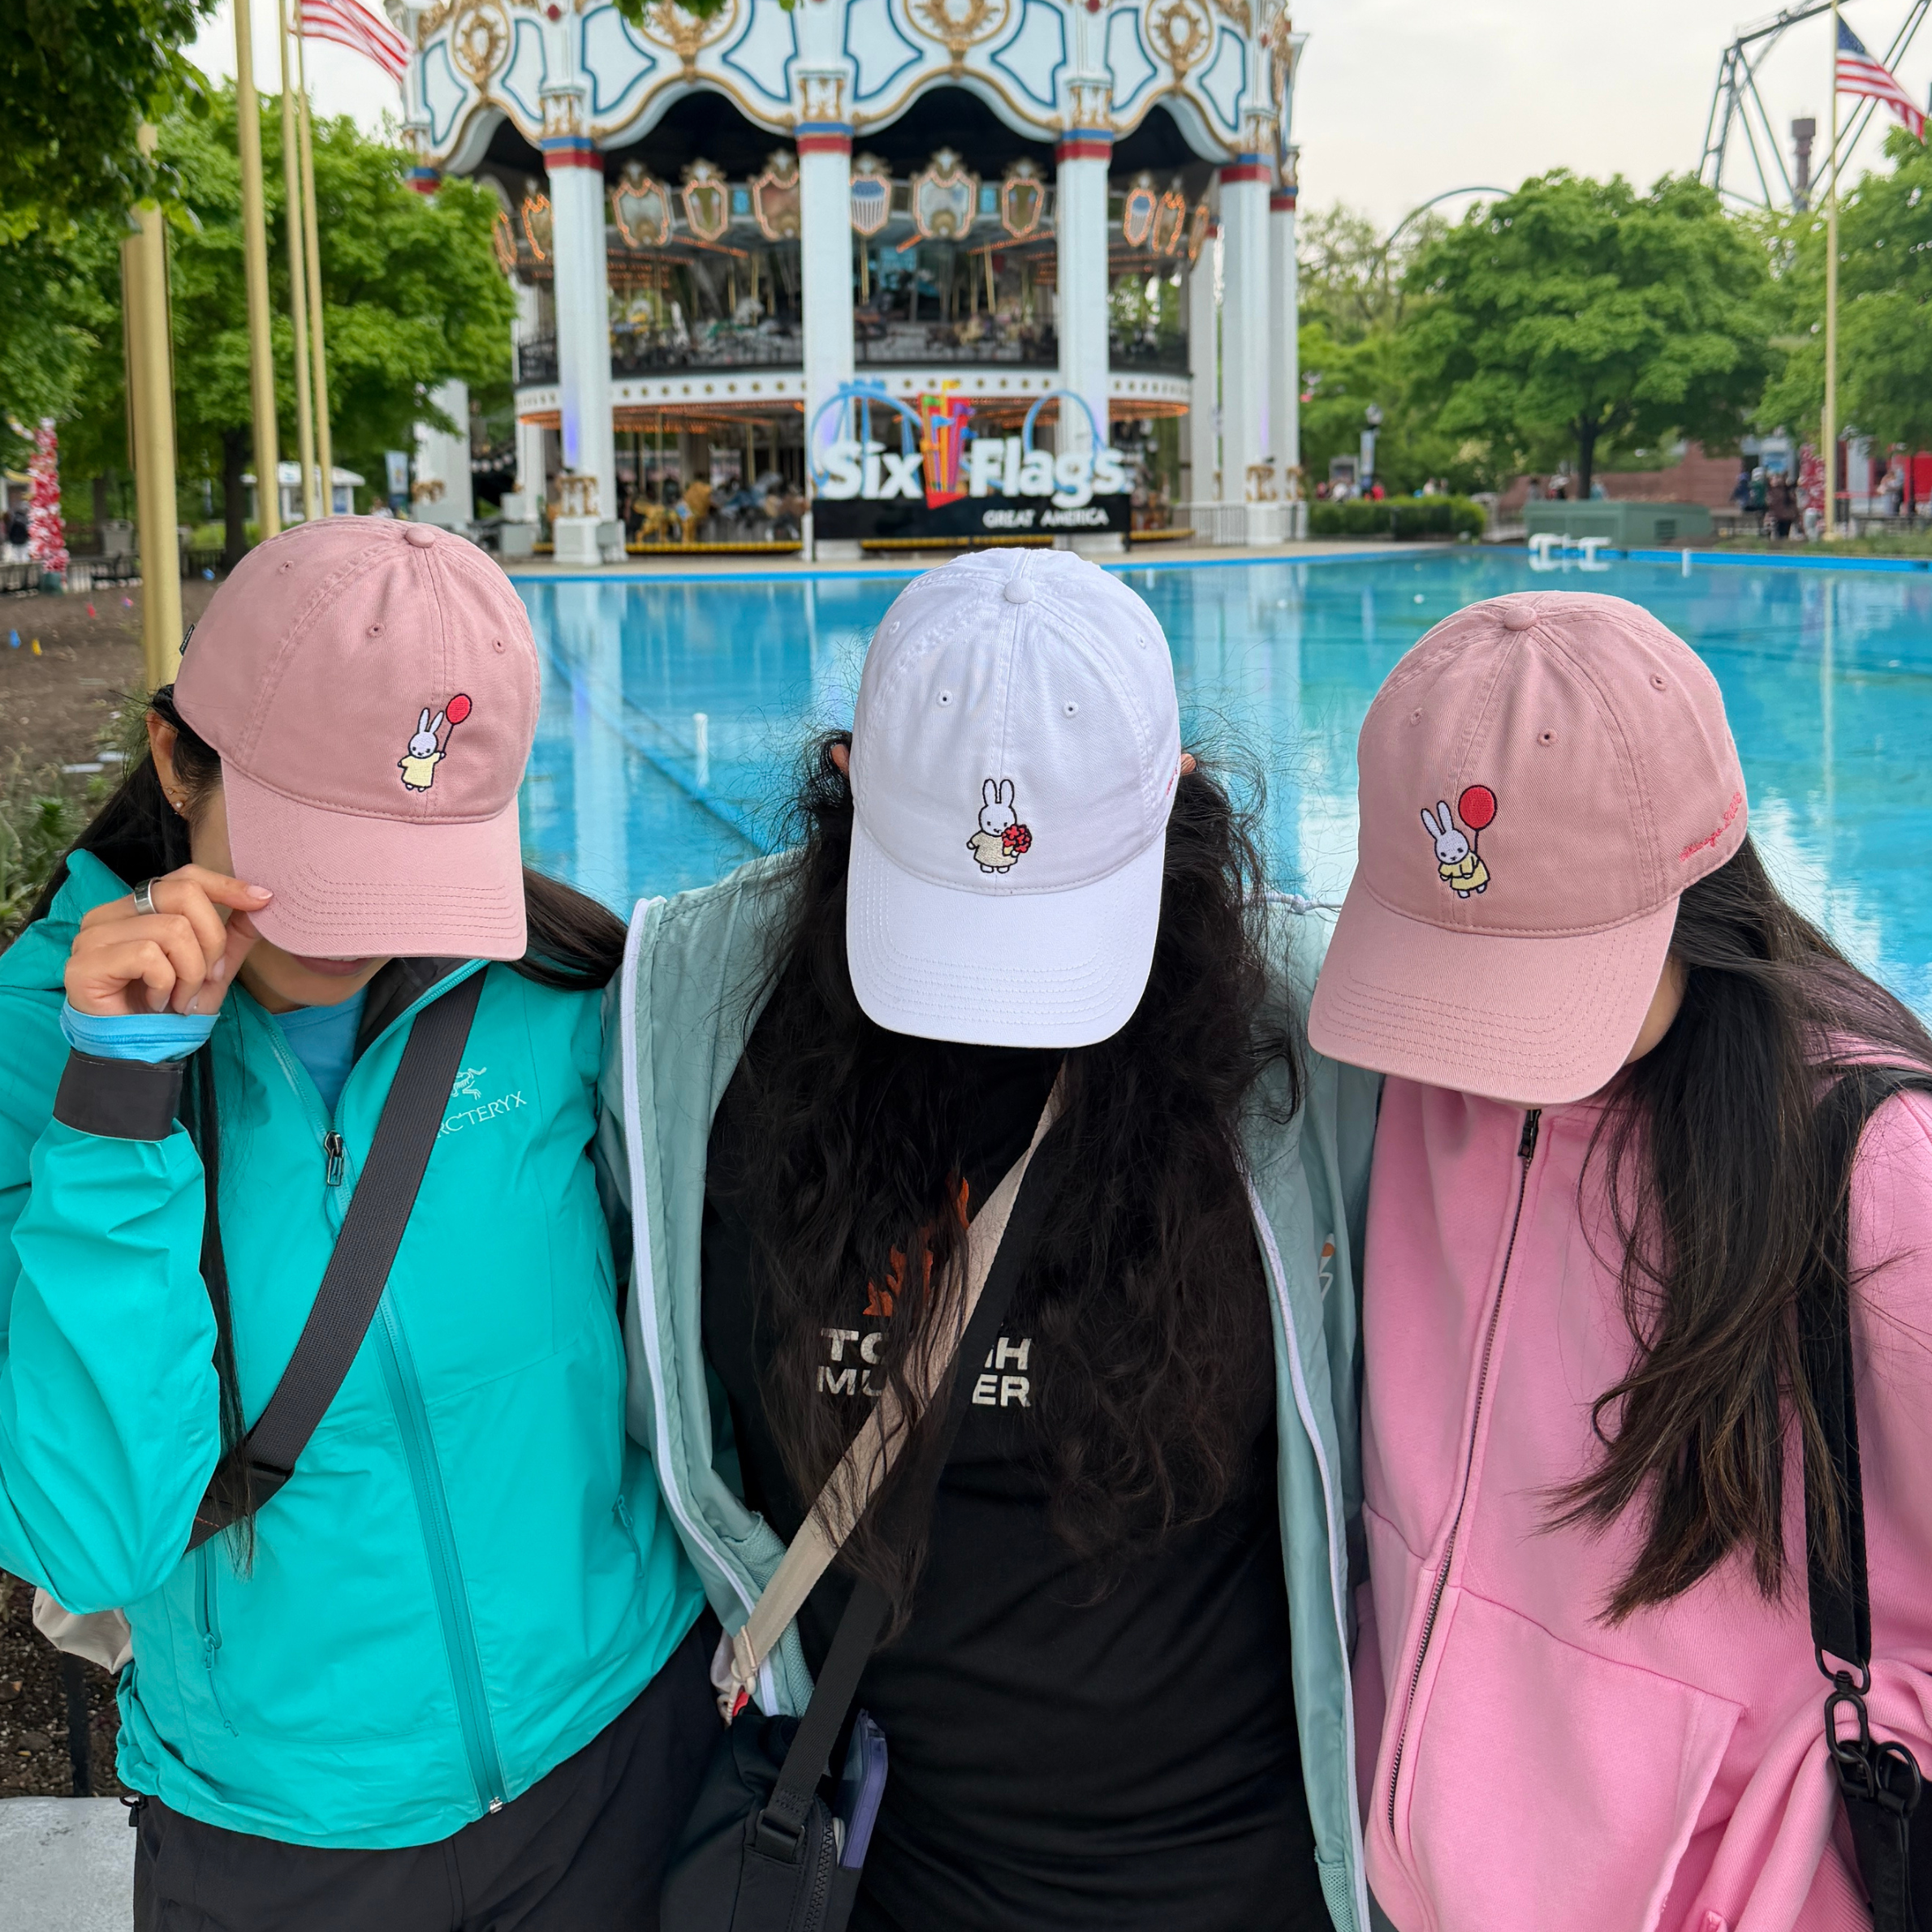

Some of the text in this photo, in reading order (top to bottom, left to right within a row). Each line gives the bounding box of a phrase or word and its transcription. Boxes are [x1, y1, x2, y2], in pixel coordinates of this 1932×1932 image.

[816, 436, 1126, 510] Six Flags
[982, 507, 1110, 528] GREAT AMERICA
[820, 1327, 1033, 1371] TOH
